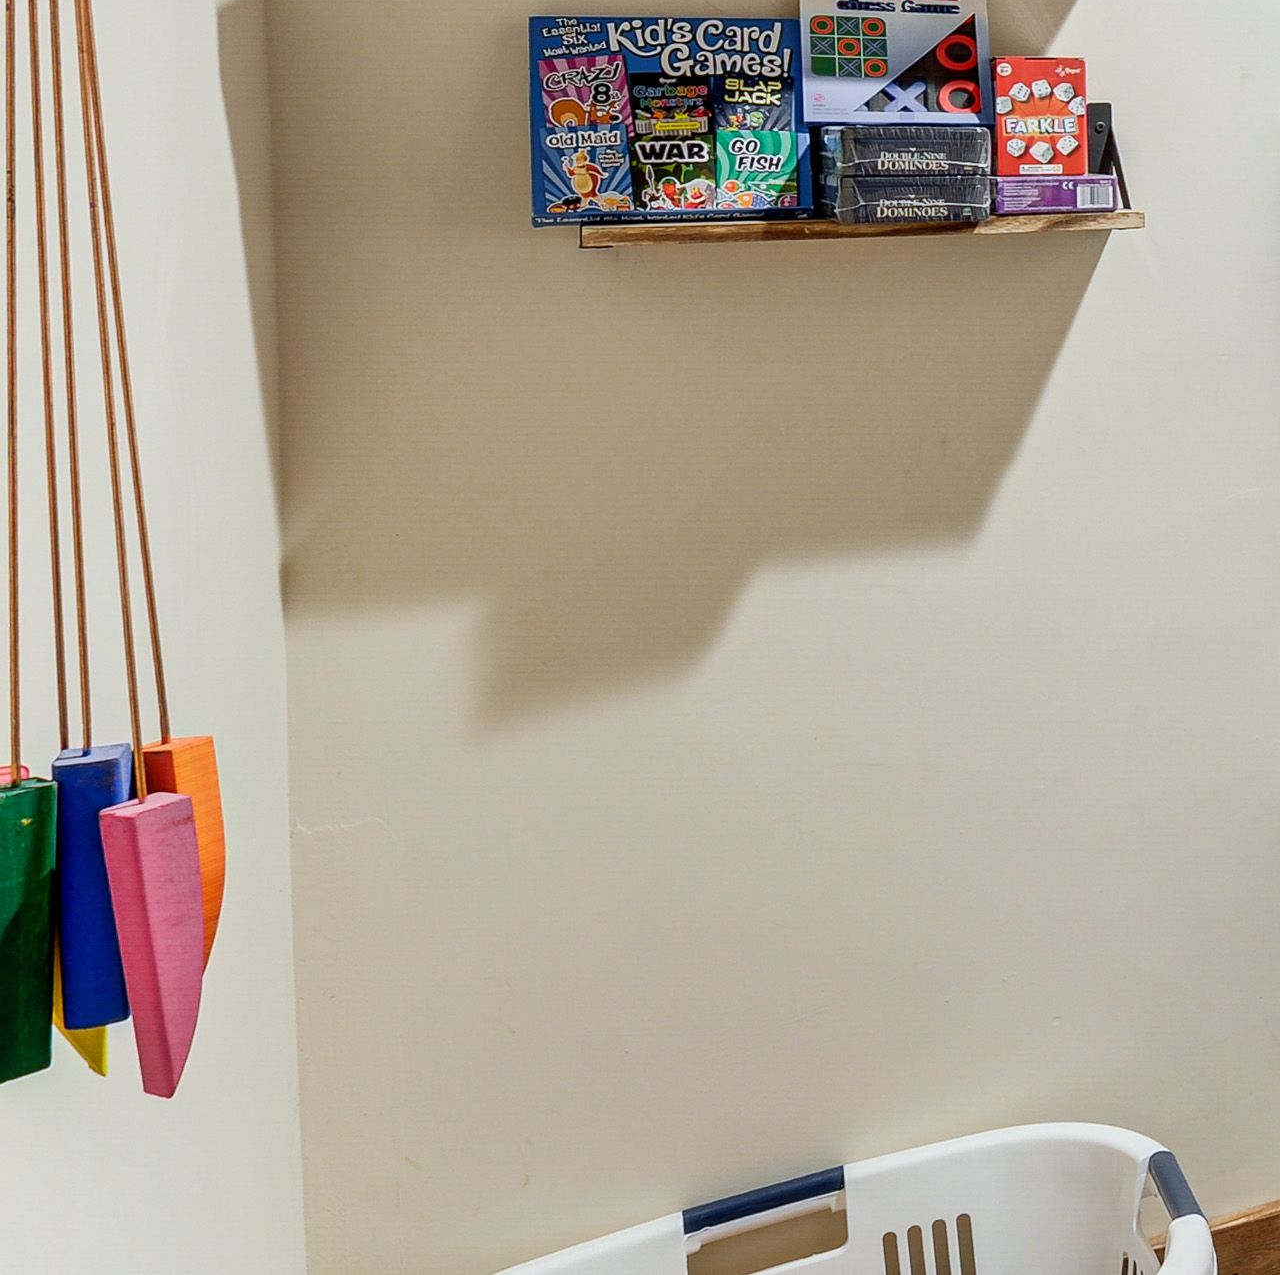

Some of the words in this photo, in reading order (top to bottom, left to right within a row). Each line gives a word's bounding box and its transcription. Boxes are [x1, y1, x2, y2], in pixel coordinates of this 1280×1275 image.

[542, 22, 601, 37] Essential
[556, 17, 577, 27] The
[562, 33, 589, 45] Six
[607, 19, 694, 57] Kid's
[695, 19, 783, 54] Card
[543, 44, 570, 57] Most
[569, 41, 608, 55] Wanted
[660, 43, 792, 78] Games!
[543, 61, 623, 92] CRAZY
[633, 85, 708, 98] Garbage
[724, 78, 783, 93] SLAP
[640, 97, 704, 108] Monsters
[724, 91, 782, 106] JACK
[1005, 117, 1077, 134] FARKLE
[580, 132, 619, 145] Maid
[730, 139, 758, 153] GO
[636, 142, 708, 161] WAR
[737, 156, 783, 171] FISH
[877, 159, 949, 171] DOMINOES
[876, 207, 949, 218] DOMINOES
